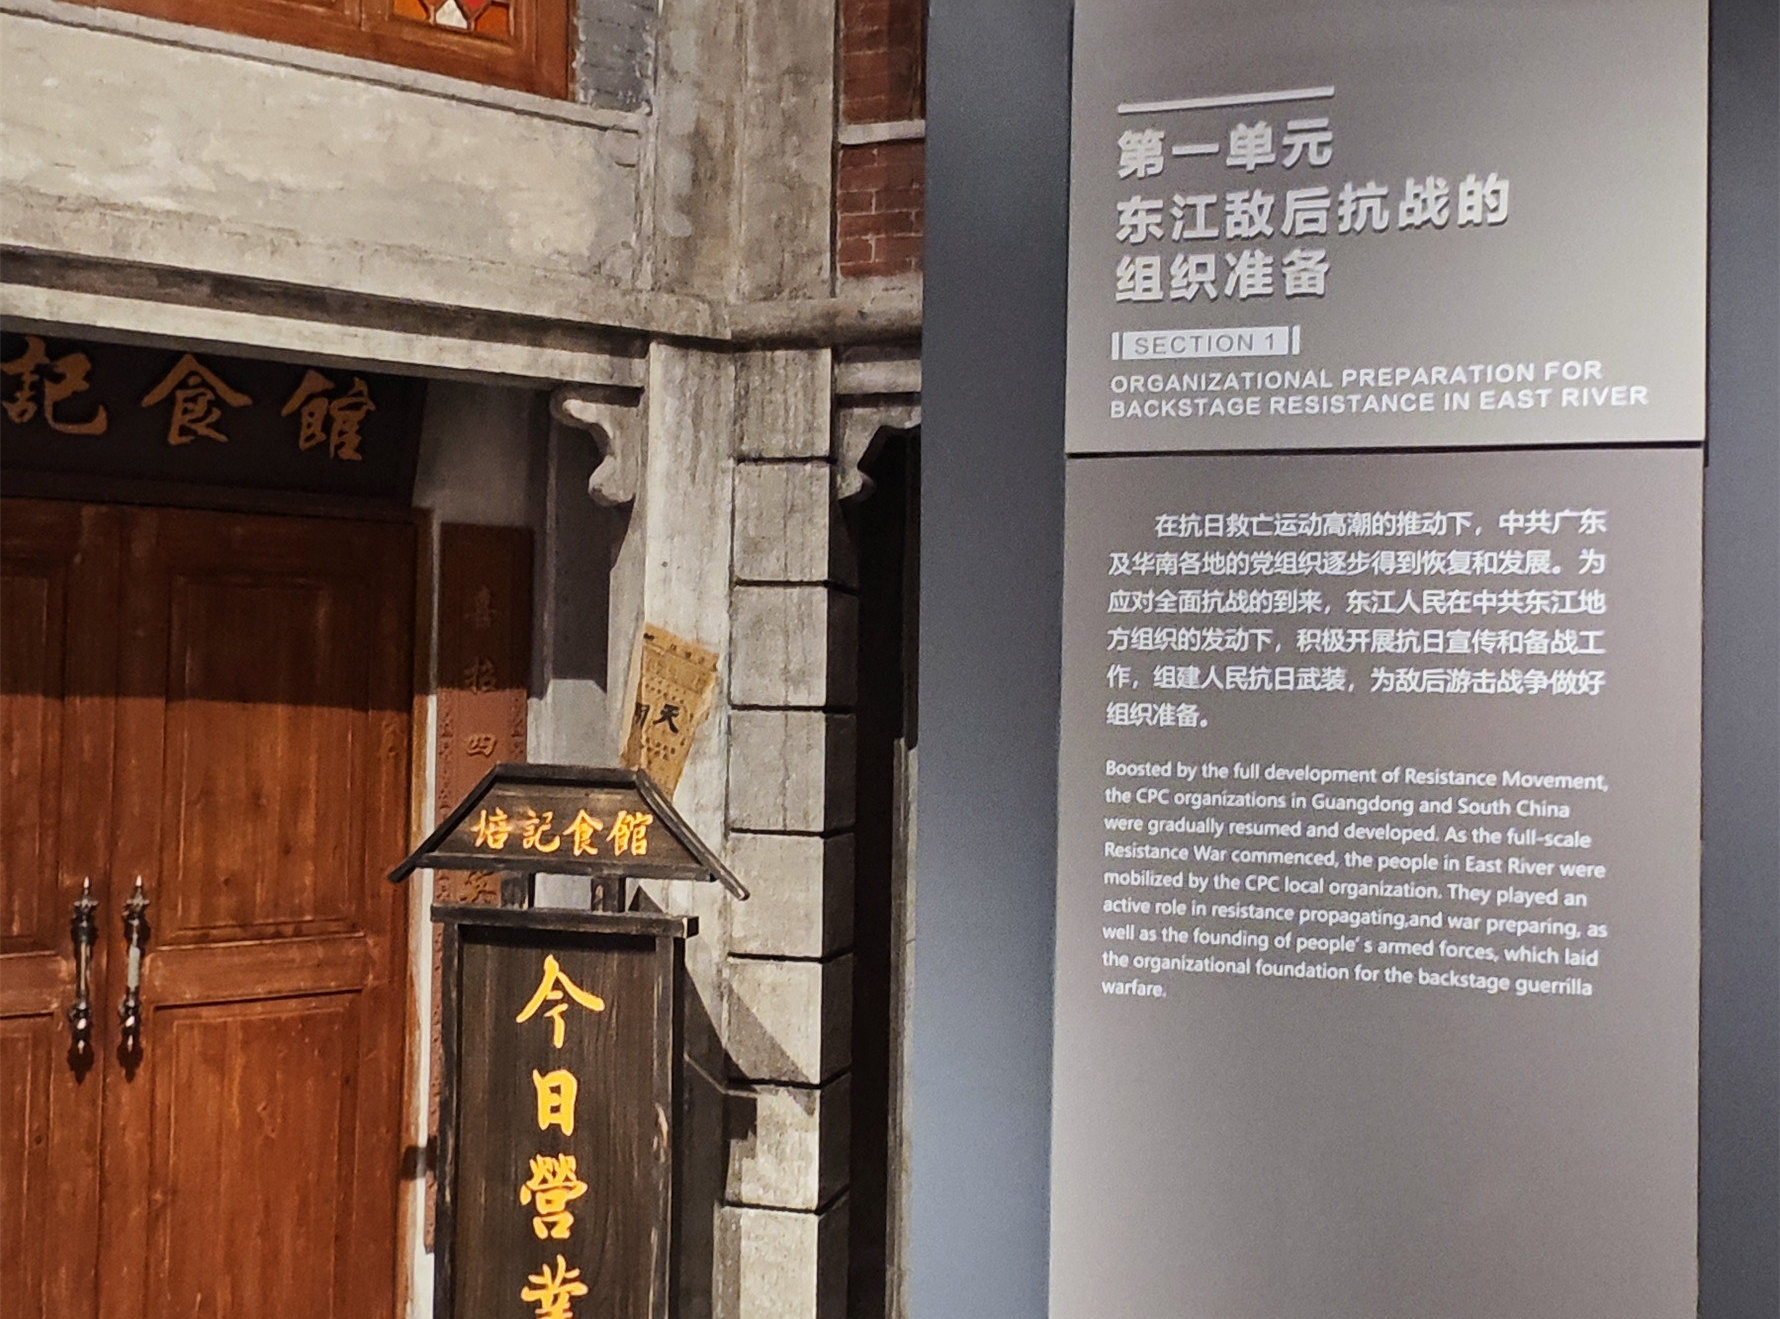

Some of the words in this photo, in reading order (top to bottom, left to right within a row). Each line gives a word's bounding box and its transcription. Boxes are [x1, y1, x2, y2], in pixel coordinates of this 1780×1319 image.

[1118, 118, 1332, 178] 第一单元
[1116, 173, 1509, 242] 东江敌后抗战的
[1116, 246, 1329, 303] 组织准备
[1133, 333, 1254, 356] SECTION
[1264, 332, 1275, 351] 1
[1111, 369, 1332, 393] ORGANIZATIONAL
[1342, 364, 1534, 387] PREPARATION
[1545, 361, 1601, 380] FOR
[1111, 397, 1261, 418] BACKSTAGE
[1270, 393, 1434, 414] RESISTANCE
[1445, 392, 1469, 410] IN
[1480, 389, 1551, 409] EAST
[1562, 386, 1648, 406] RIVER
[1155, 509, 1606, 537] 在抗日救亡运动高潮的推动下，中共广东
[1109, 549, 1605, 575] 及华南各地的党组织逐步得到恢复和发展。为
[1108, 589, 1606, 614] 应对全面抗战的到来，东江人民在中共东江地
[1107, 627, 1605, 654] 方组织的发动下，积极开展抗日宣传和备战工
[1107, 665, 1605, 695] 作，组建人民抗日武装，为敌后游击战争做好
[1107, 702, 1207, 727] 组织准备。
[1106, 760, 1171, 776] Boosted
[1177, 761, 1197, 781] by
[1202, 762, 1228, 778] the
[1234, 762, 1259, 779] full
[1265, 764, 1377, 785] development
[1382, 767, 1400, 783] of
[1405, 768, 1497, 786] Resistance
[1503, 771, 1608, 792] Movement,
[1105, 787, 1131, 803] the
[1136, 788, 1169, 804] CPC
[1174, 790, 1286, 809] organizations
[1292, 792, 1306, 808] in
[1312, 794, 1414, 816] Guangdong
[1419, 797, 1452, 813] and
[1458, 798, 1511, 815] South
[1517, 800, 1570, 817] China
[470, 806, 654, 857] 培記食館
[1104, 818, 1143, 831] were
[1148, 817, 1224, 838] gradually
[1229, 821, 1301, 837] resumed
[1306, 822, 1338, 838] and
[1344, 823, 1439, 844] developed.
[1445, 827, 1467, 842] As
[1472, 827, 1501, 844] the
[1507, 828, 1591, 848] full-scale
[1105, 842, 1188, 860] Resistance
[1194, 845, 1227, 861] War
[1232, 850, 1339, 868] commenced,
[1344, 851, 1373, 867] the
[1378, 854, 1438, 873] people
[1444, 855, 1459, 871] in
[1466, 856, 1502, 873] East
[1508, 858, 1555, 875] River
[1560, 864, 1605, 878] were
[1104, 870, 1183, 887] mobilized
[1189, 872, 1208, 892] by
[1214, 873, 1240, 890] the
[1245, 875, 1279, 892] CPC
[1285, 876, 1324, 893] local
[1329, 880, 1442, 899] organization.
[1447, 884, 1491, 905] They
[1497, 886, 1558, 907] played
[1564, 894, 1587, 906] an
[1104, 897, 1150, 913] active
[1156, 899, 1186, 915] role
[1192, 900, 1206, 916] in
[1212, 902, 1294, 920] resistance
[1448, 917, 1481, 929] war
[1487, 918, 1581, 940] preparing,
[1587, 925, 1607, 937] as
[1103, 924, 1134, 940] well
[1139, 929, 1156, 941] as
[1162, 926, 1188, 943] the
[1194, 928, 1268, 951] founding
[1274, 932, 1291, 948] of
[1378, 940, 1434, 956] armed
[1439, 940, 1498, 962] forces,
[1504, 946, 1558, 963] which
[1565, 948, 1598, 966] laid
[1102, 979, 1166, 997] warfare.
[1103, 951, 1128, 967] the
[1133, 955, 1250, 974] organizational
[1256, 958, 1349, 979] foundation
[1354, 964, 1380, 981] for
[1384, 966, 1413, 983] the
[1419, 968, 1510, 993] backstage
[1516, 978, 1592, 995] guerrilla
